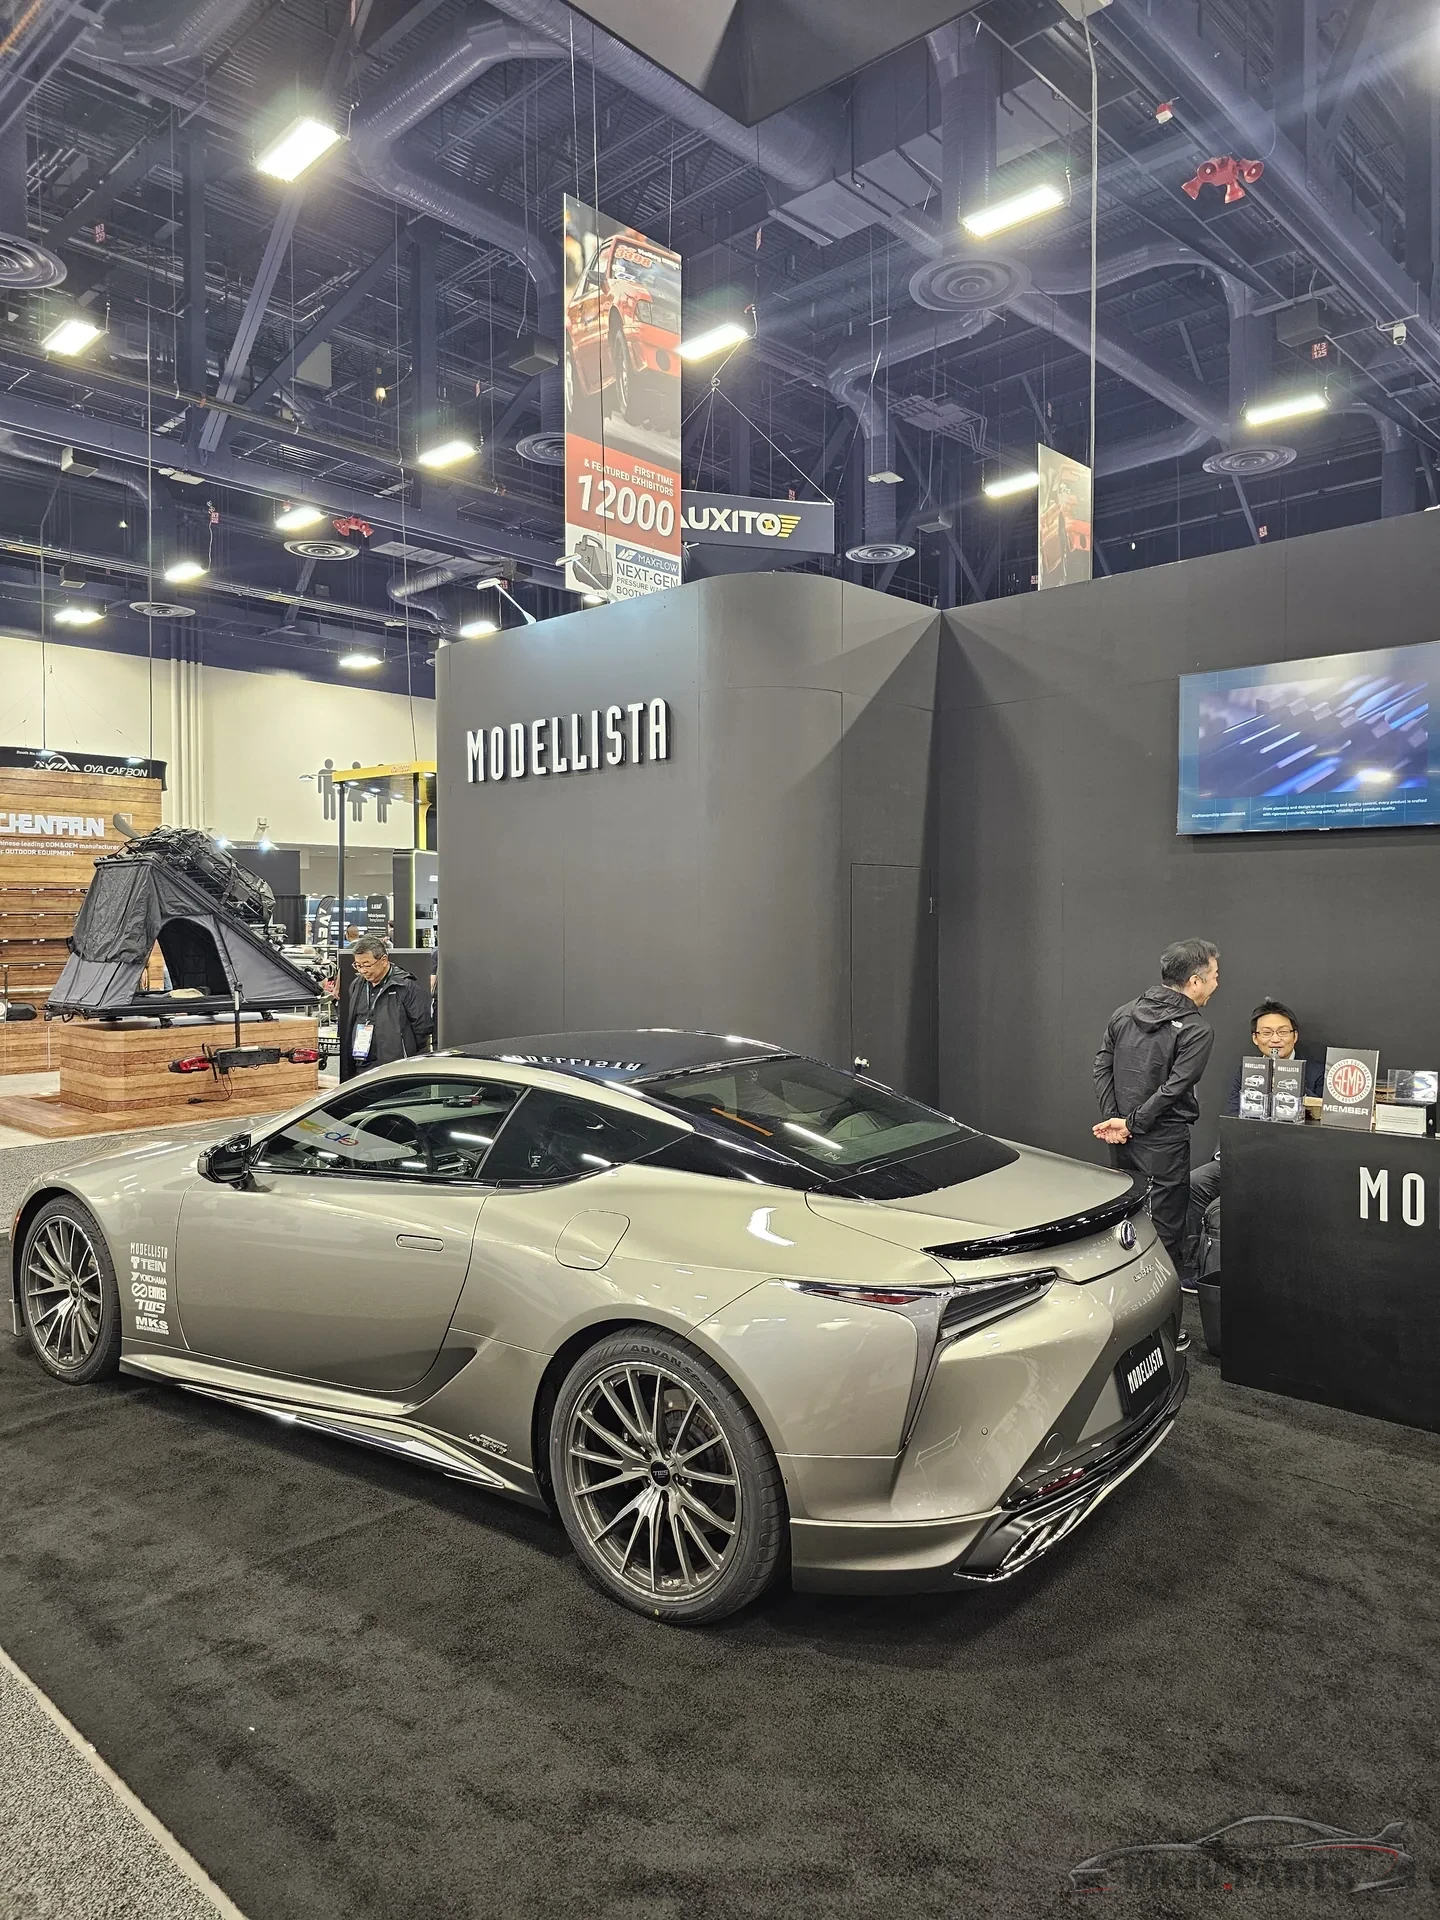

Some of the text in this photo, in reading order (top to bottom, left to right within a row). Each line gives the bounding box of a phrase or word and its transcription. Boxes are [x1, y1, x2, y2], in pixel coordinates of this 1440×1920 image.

[583, 458, 674, 497] & FEATURED EXHIBITORS
[634, 465, 674, 487] FIRST TIME
[578, 474, 675, 537] 12000
[616, 561, 678, 588] NEXT-GEN
[638, 554, 678, 573] MAXFLOW
[616, 577, 648, 590] PRESSURE
[467, 697, 667, 783] MODELLISTA
[84, 764, 104, 773] OYA
[21, 841, 44, 849] leading
[79, 843, 120, 851] manufacturer
[1334, 1066, 1365, 1096] SEMA
[1323, 1104, 1369, 1116] MEMBER
[1359, 1166, 1440, 1229] MO
[130, 1242, 168, 1260] MODELLISTA
[140, 1257, 167, 1273] TEIN
[135, 1316, 168, 1330] MKS
[630, 1344, 682, 1368] ADVAN
[1127, 1346, 1164, 1394] MODELLISTA
